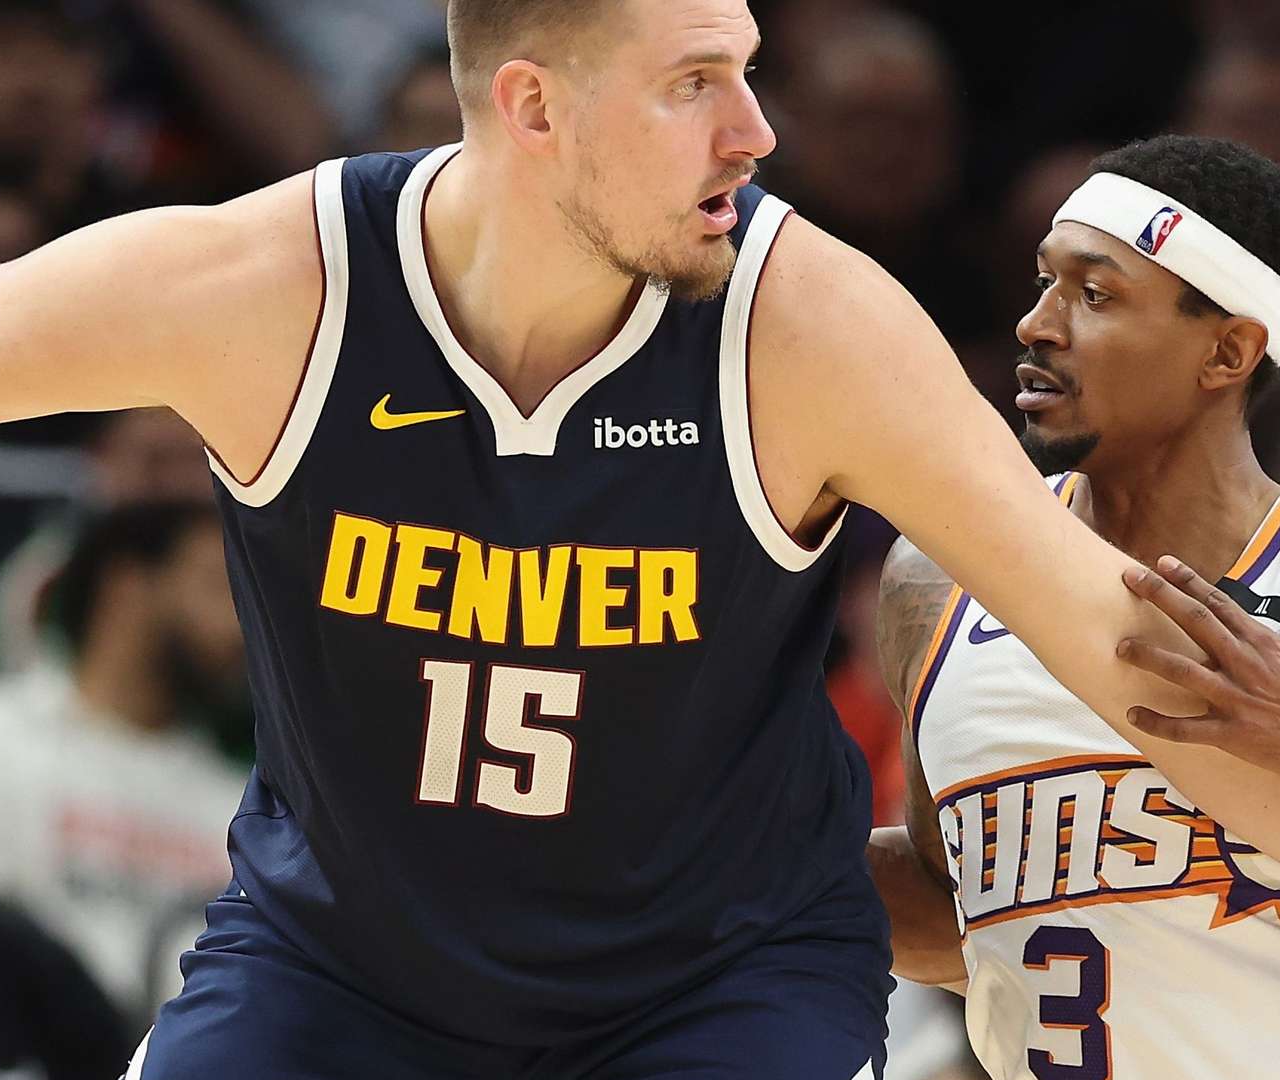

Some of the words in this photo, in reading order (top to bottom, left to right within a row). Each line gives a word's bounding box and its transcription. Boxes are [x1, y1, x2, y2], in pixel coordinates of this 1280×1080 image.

[593, 416, 700, 449] ibotta
[320, 509, 701, 648] DENVER
[1253, 597, 1272, 615] AL
[415, 658, 586, 818] 15
